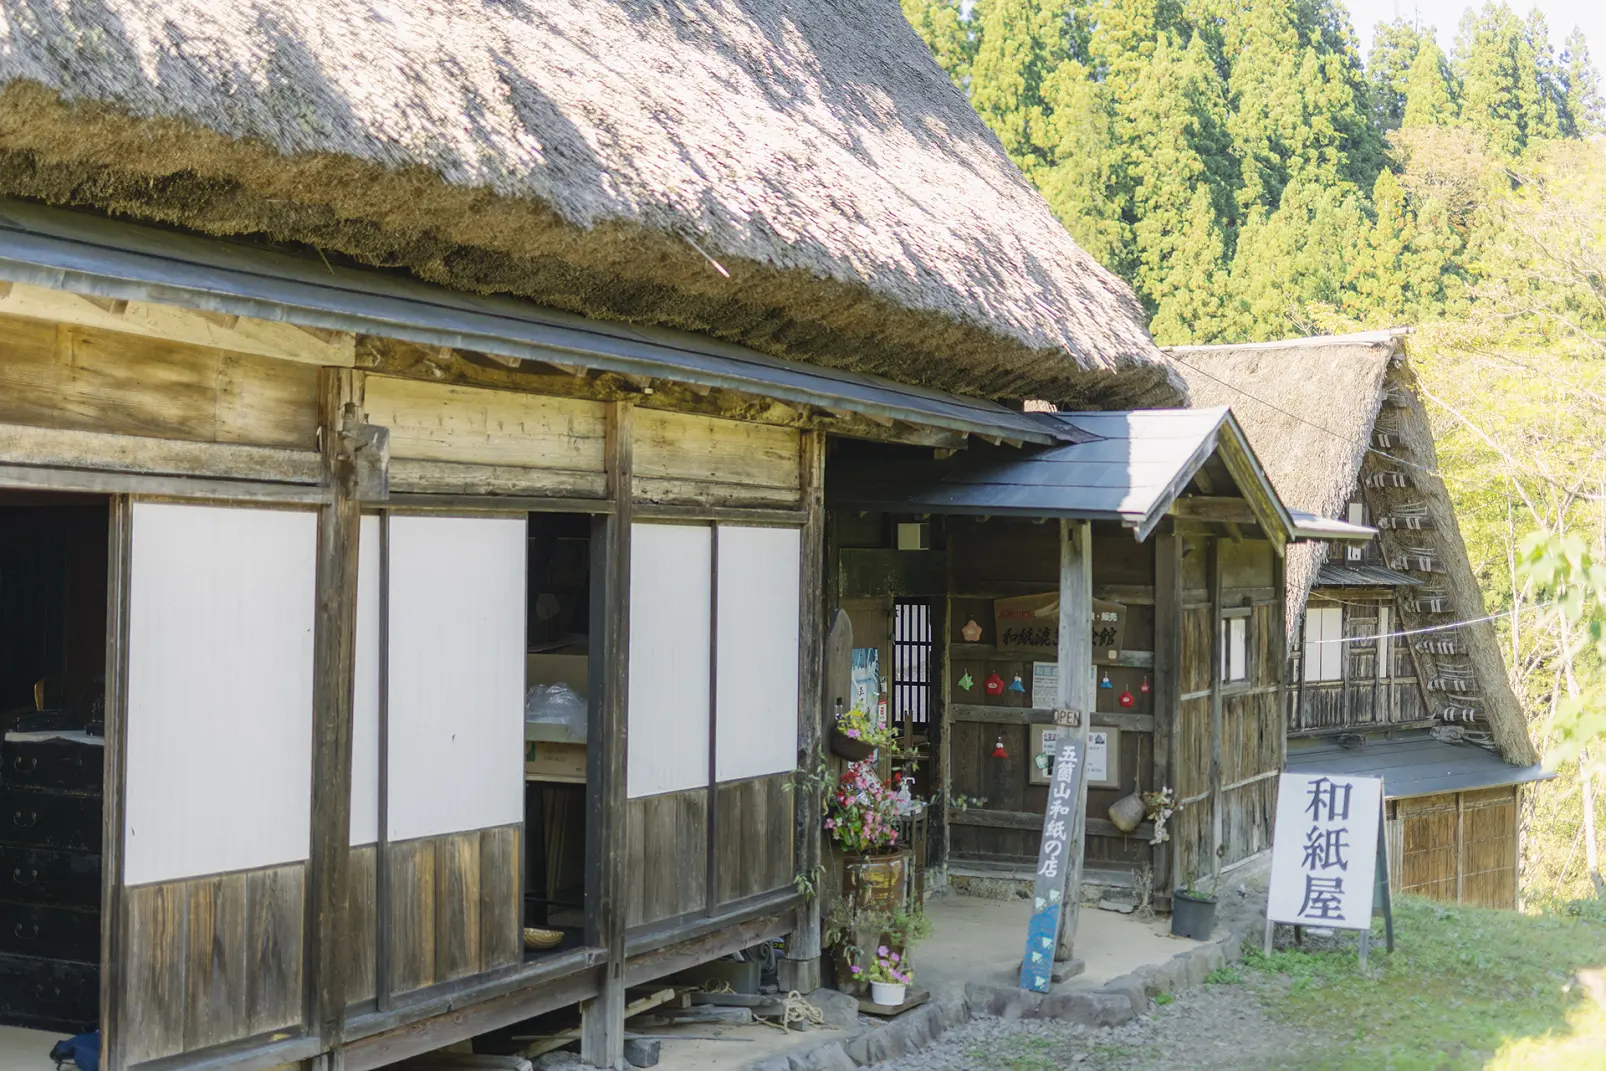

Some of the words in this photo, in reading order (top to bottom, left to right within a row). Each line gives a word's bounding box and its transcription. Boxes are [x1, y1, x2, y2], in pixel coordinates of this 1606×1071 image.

[1053, 710, 1080, 726] OPEN
[1038, 745, 1077, 878] 五箇山和紙の店
[1297, 776, 1353, 921] 和紙屋
